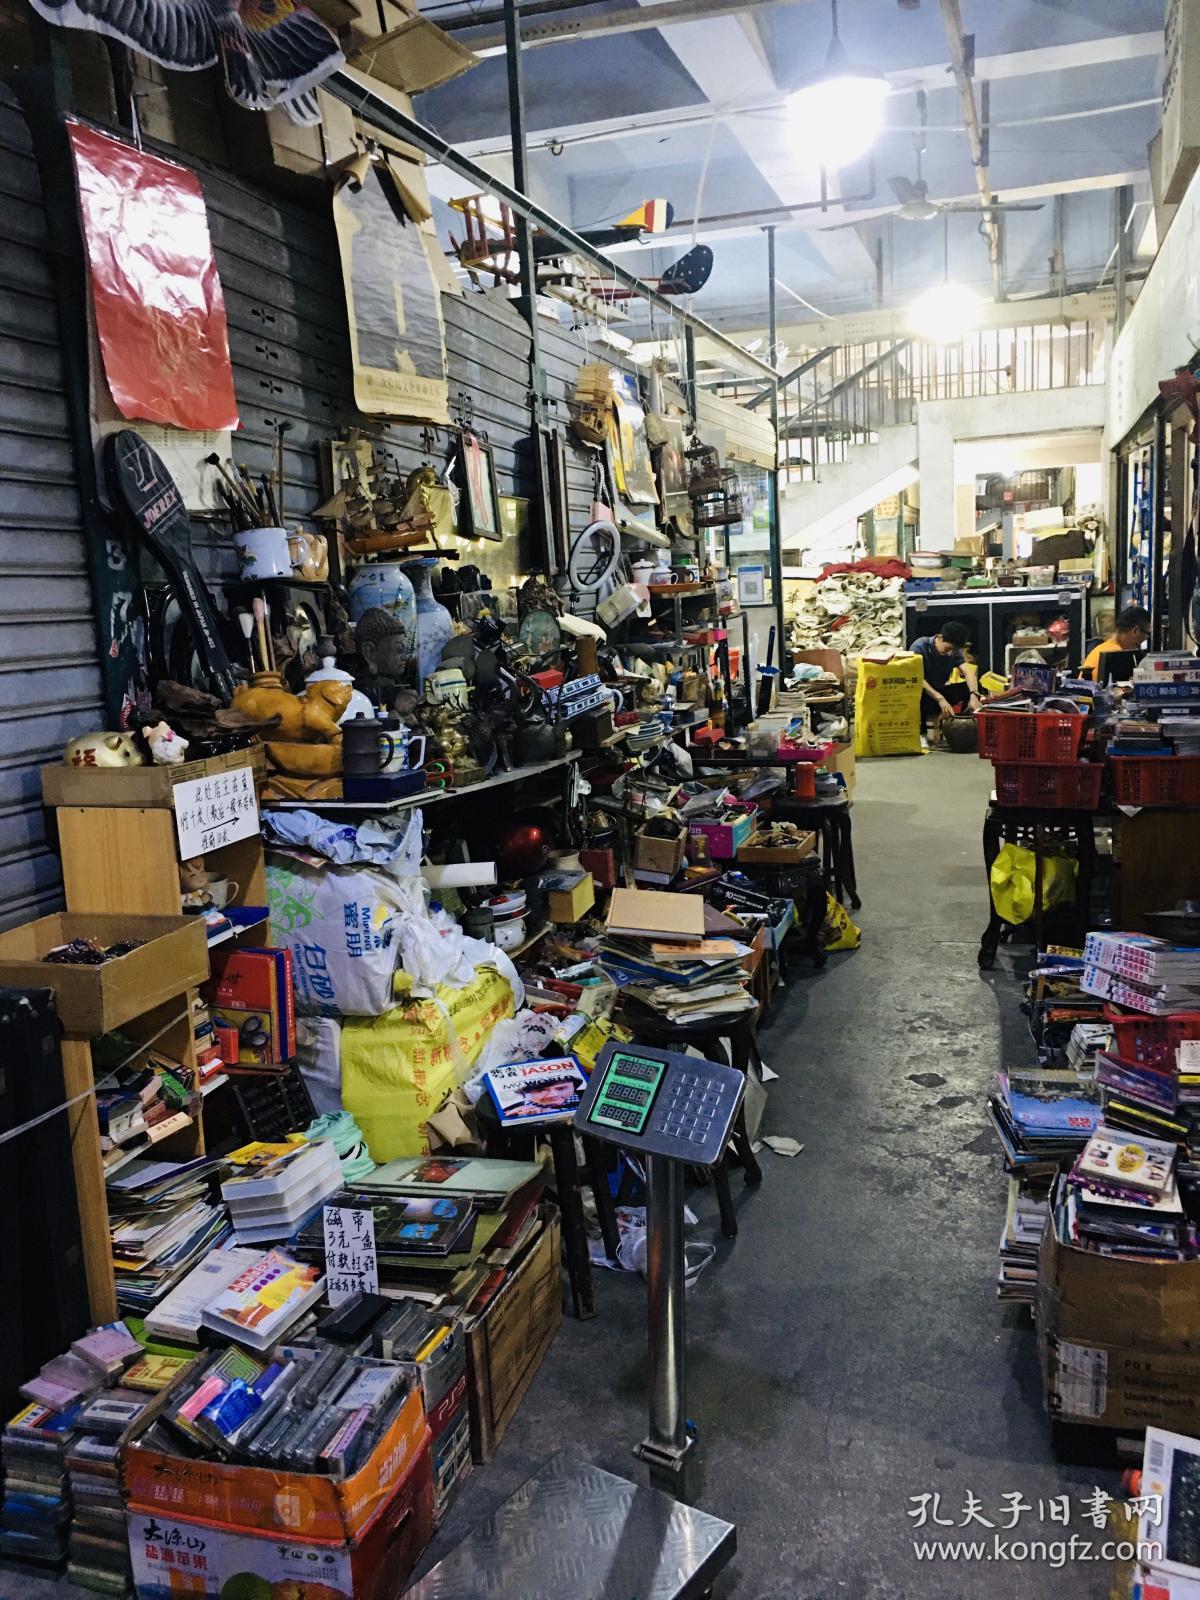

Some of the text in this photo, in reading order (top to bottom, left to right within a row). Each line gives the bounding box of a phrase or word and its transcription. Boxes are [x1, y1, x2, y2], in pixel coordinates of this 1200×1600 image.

[143, 487, 178, 529] JOEREX
[521, 1061, 575, 1077] JASON
[438, 1375, 467, 1421] PS3
